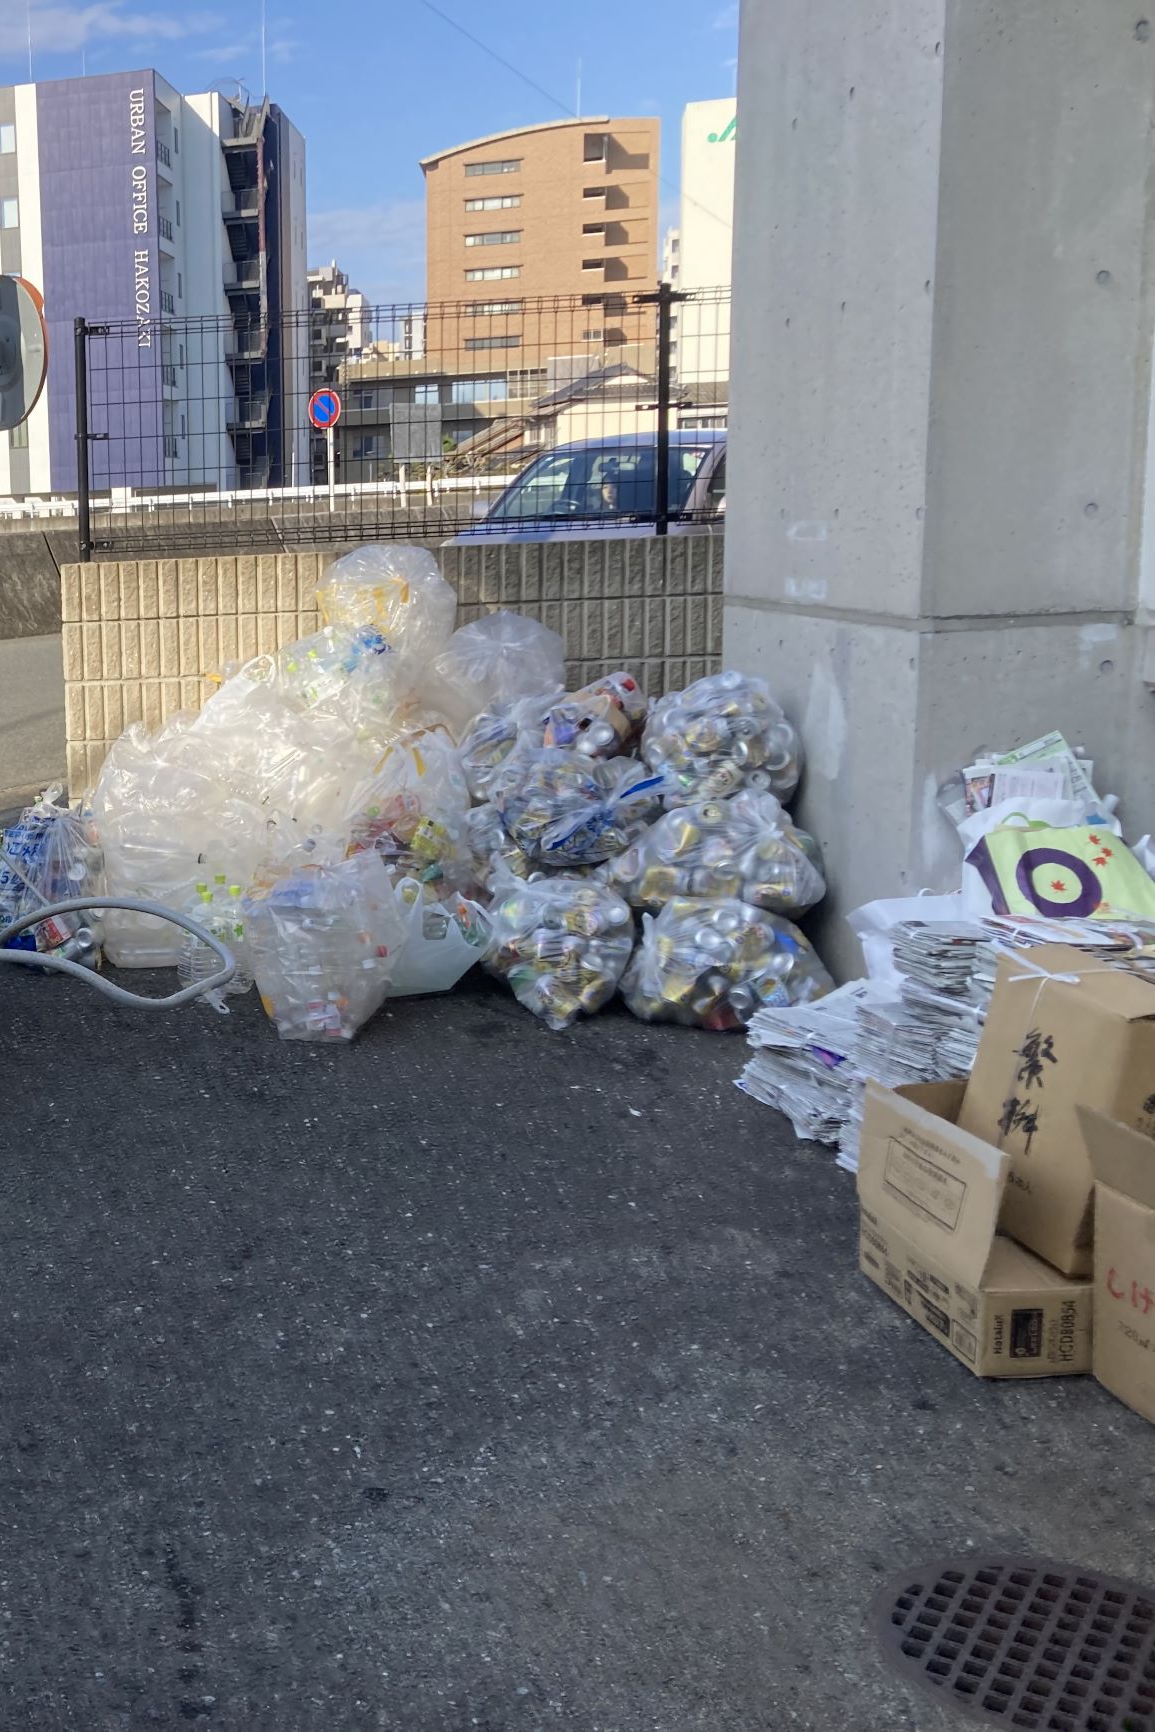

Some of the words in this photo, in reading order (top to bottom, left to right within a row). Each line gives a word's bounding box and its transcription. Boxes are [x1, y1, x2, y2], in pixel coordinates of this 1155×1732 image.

[129, 88, 146, 154] URBAN
[131, 165, 148, 234] OFFICE
[134, 249, 151, 347] HAKOZAKI
